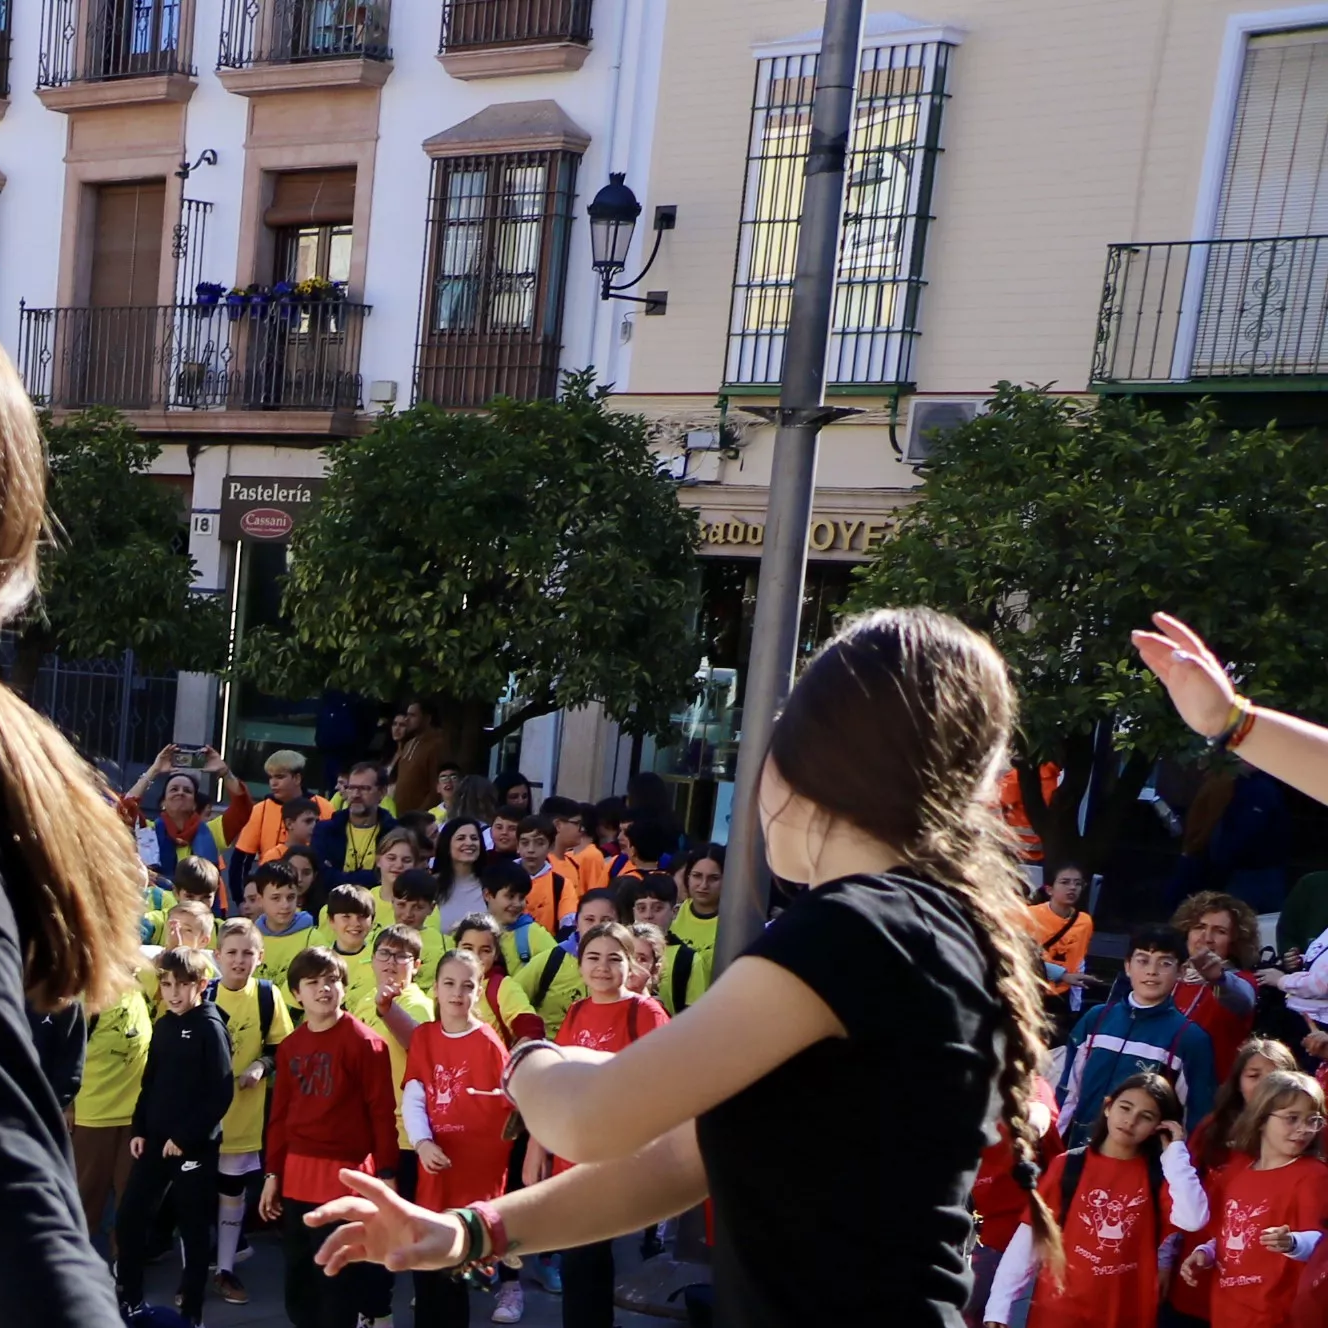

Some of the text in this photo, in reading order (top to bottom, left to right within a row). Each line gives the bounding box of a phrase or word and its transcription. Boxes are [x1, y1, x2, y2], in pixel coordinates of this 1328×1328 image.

[229, 482, 312, 503] Pastelería
[194, 517, 210, 532] 18
[245, 514, 288, 527] Cassani
[810, 517, 889, 552] OYE
